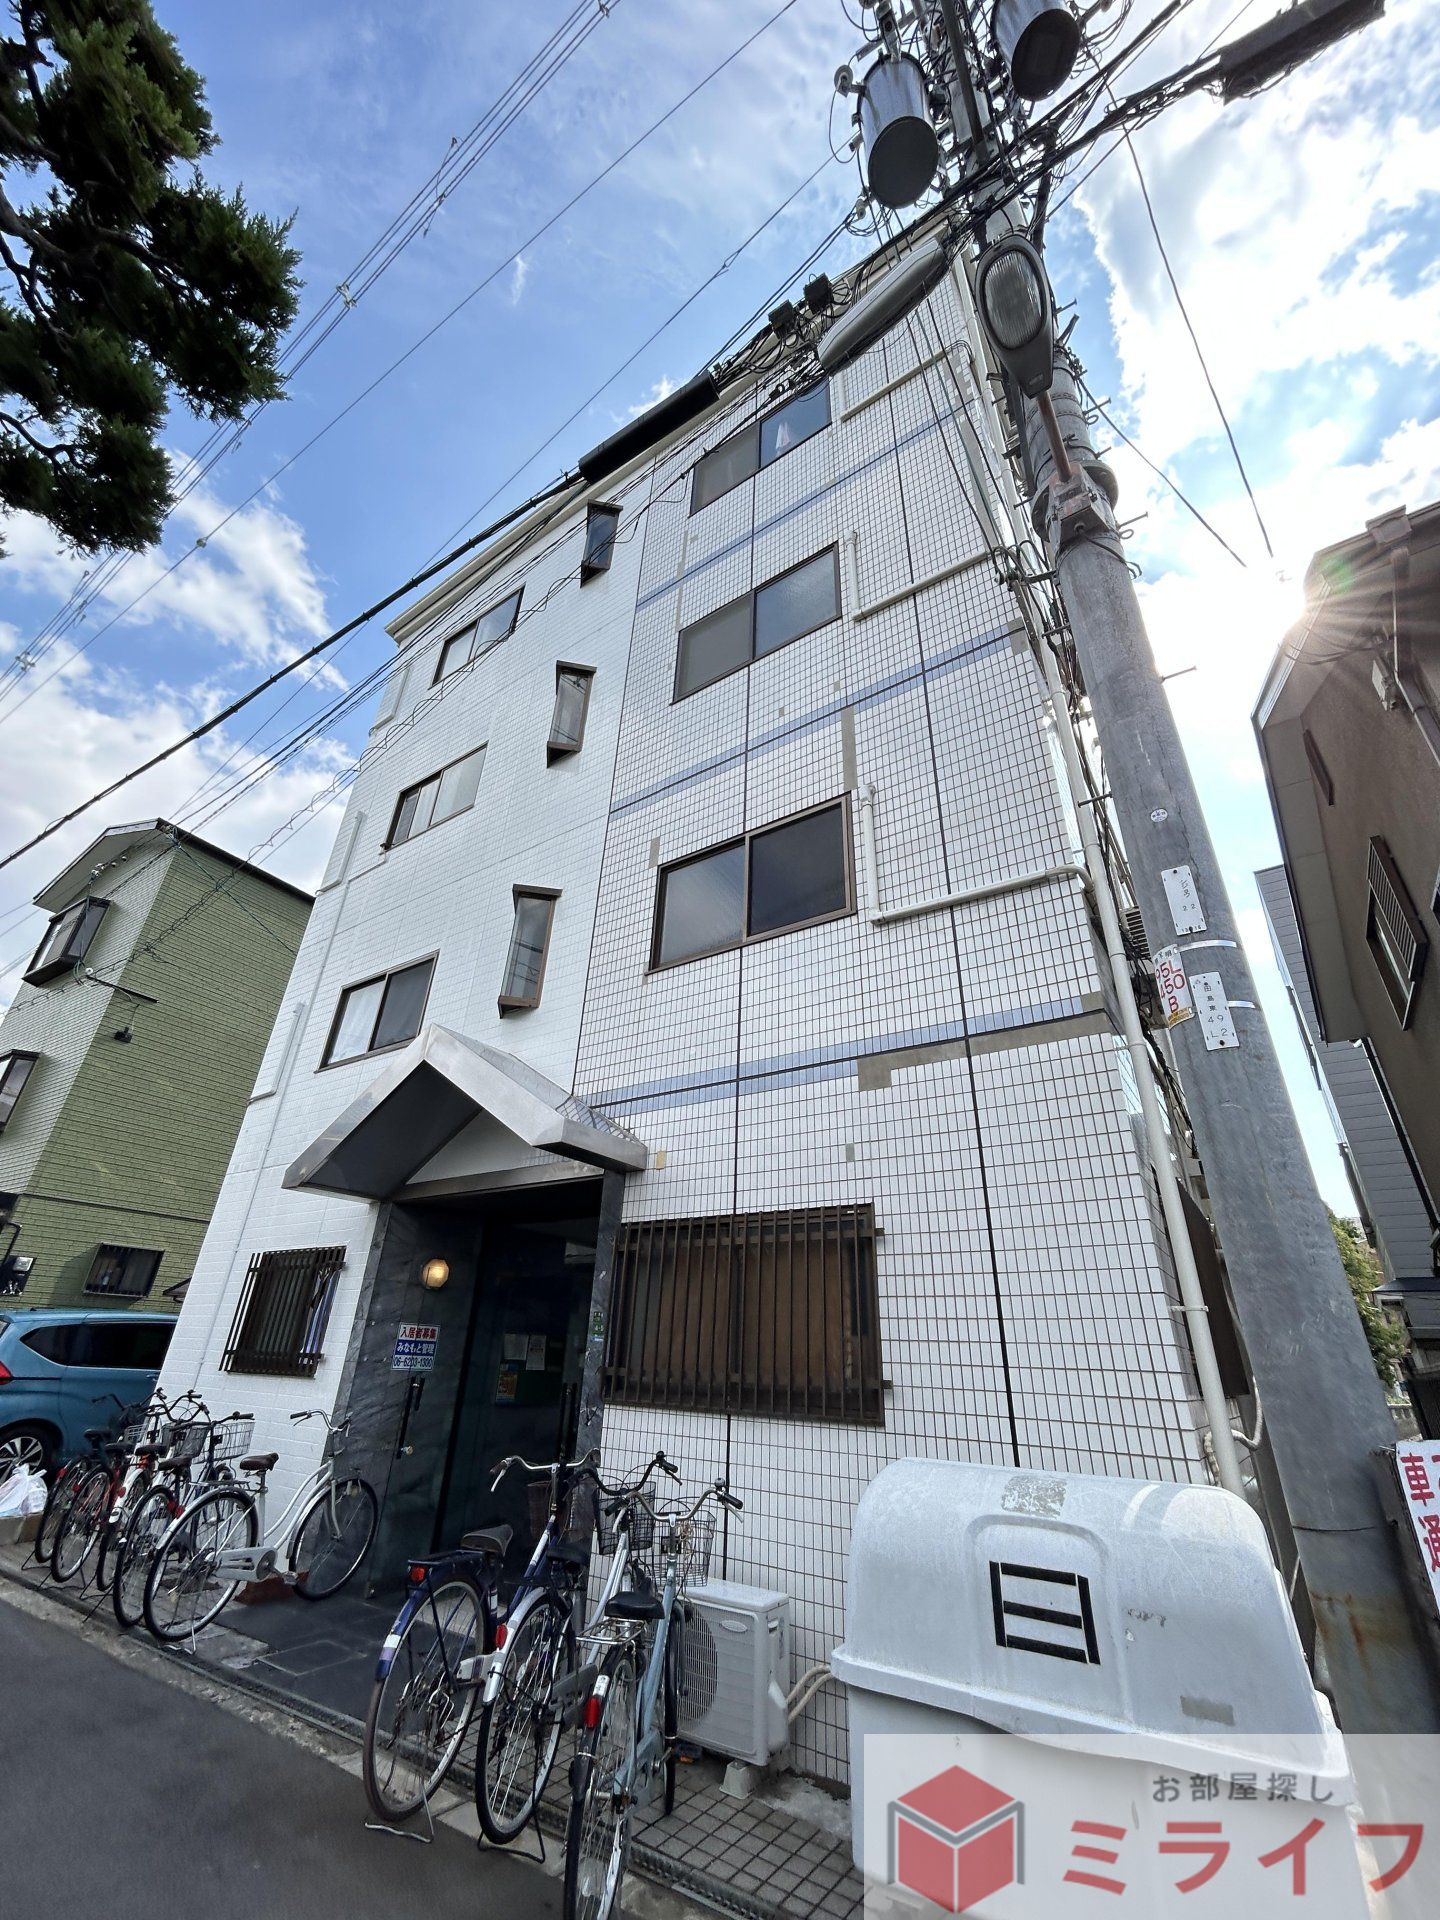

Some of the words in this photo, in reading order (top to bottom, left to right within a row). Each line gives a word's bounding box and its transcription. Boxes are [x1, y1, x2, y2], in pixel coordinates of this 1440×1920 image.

[1169, 995, 1179, 1013] B
[1208, 1014, 1224, 1024] 49
[1211, 1028, 1228, 1038] L2
[400, 1326, 437, 1341] 入居者募集
[396, 1342, 435, 1355] みなもと管理
